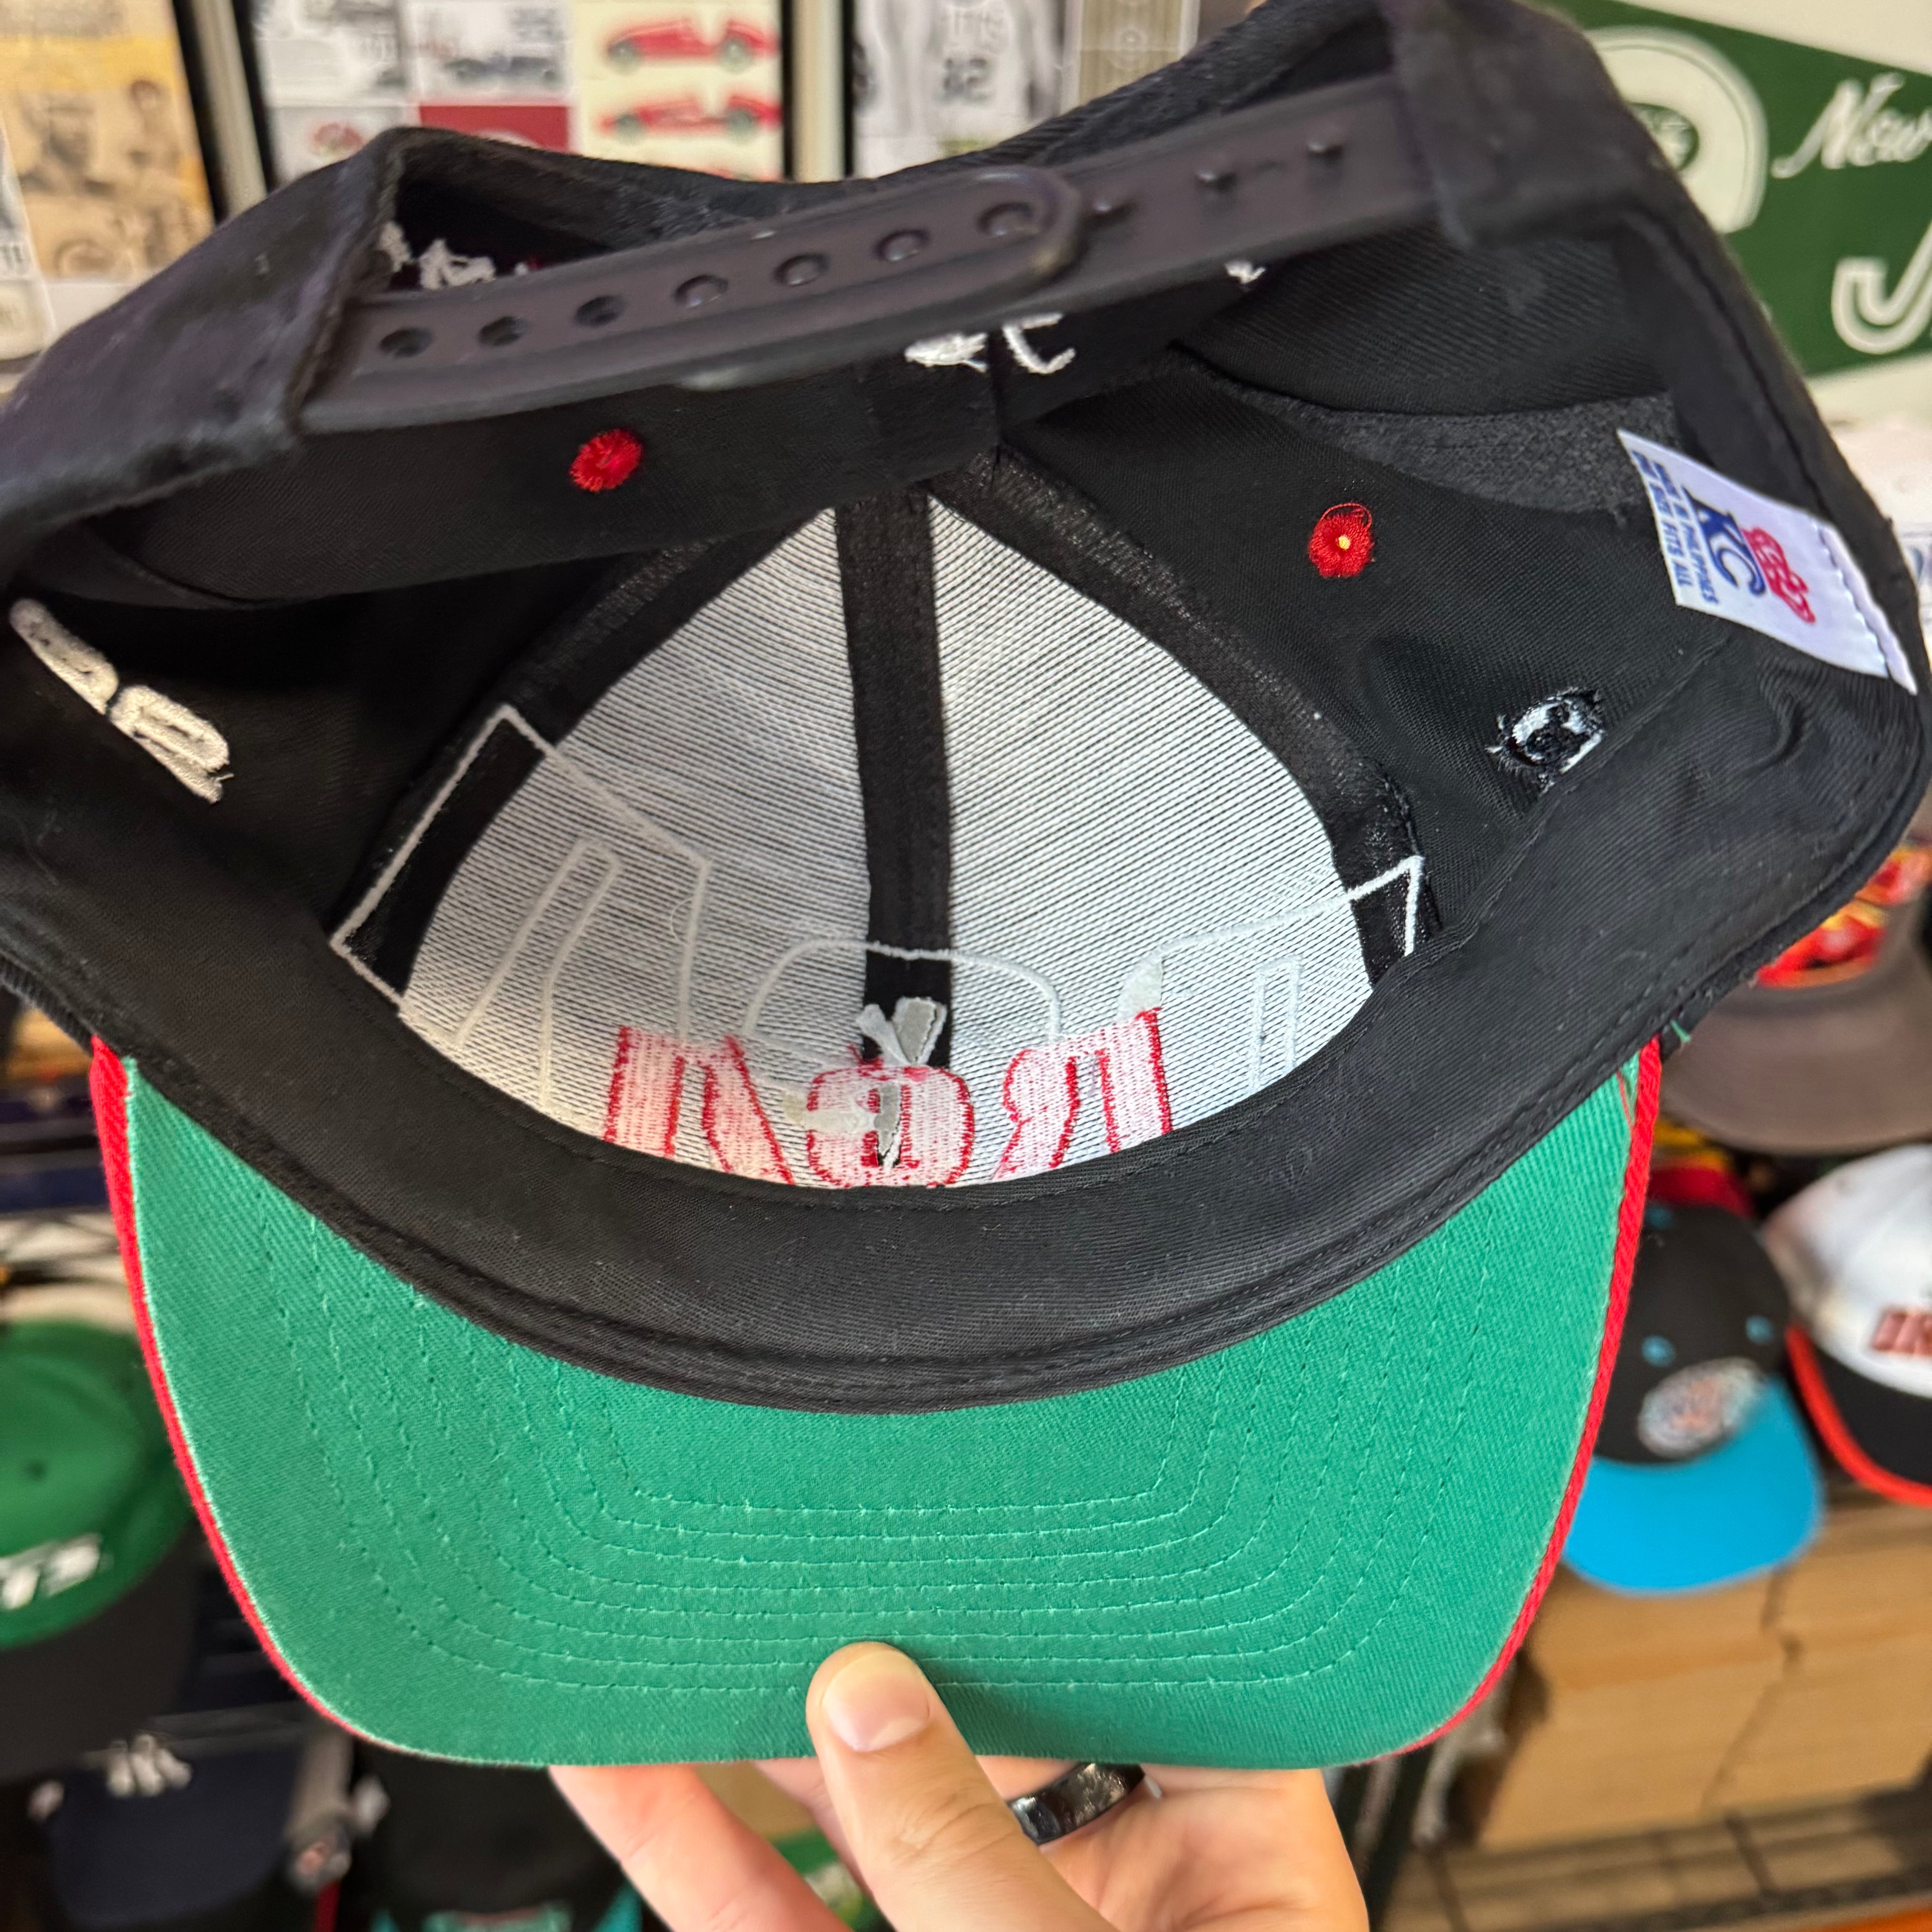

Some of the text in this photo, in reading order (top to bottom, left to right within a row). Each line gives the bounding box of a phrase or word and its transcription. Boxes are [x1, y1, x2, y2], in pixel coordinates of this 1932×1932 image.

[1663, 522, 1681, 556] FITS
[1675, 562, 1693, 586] ALL
[1682, 487, 1765, 595] KC
